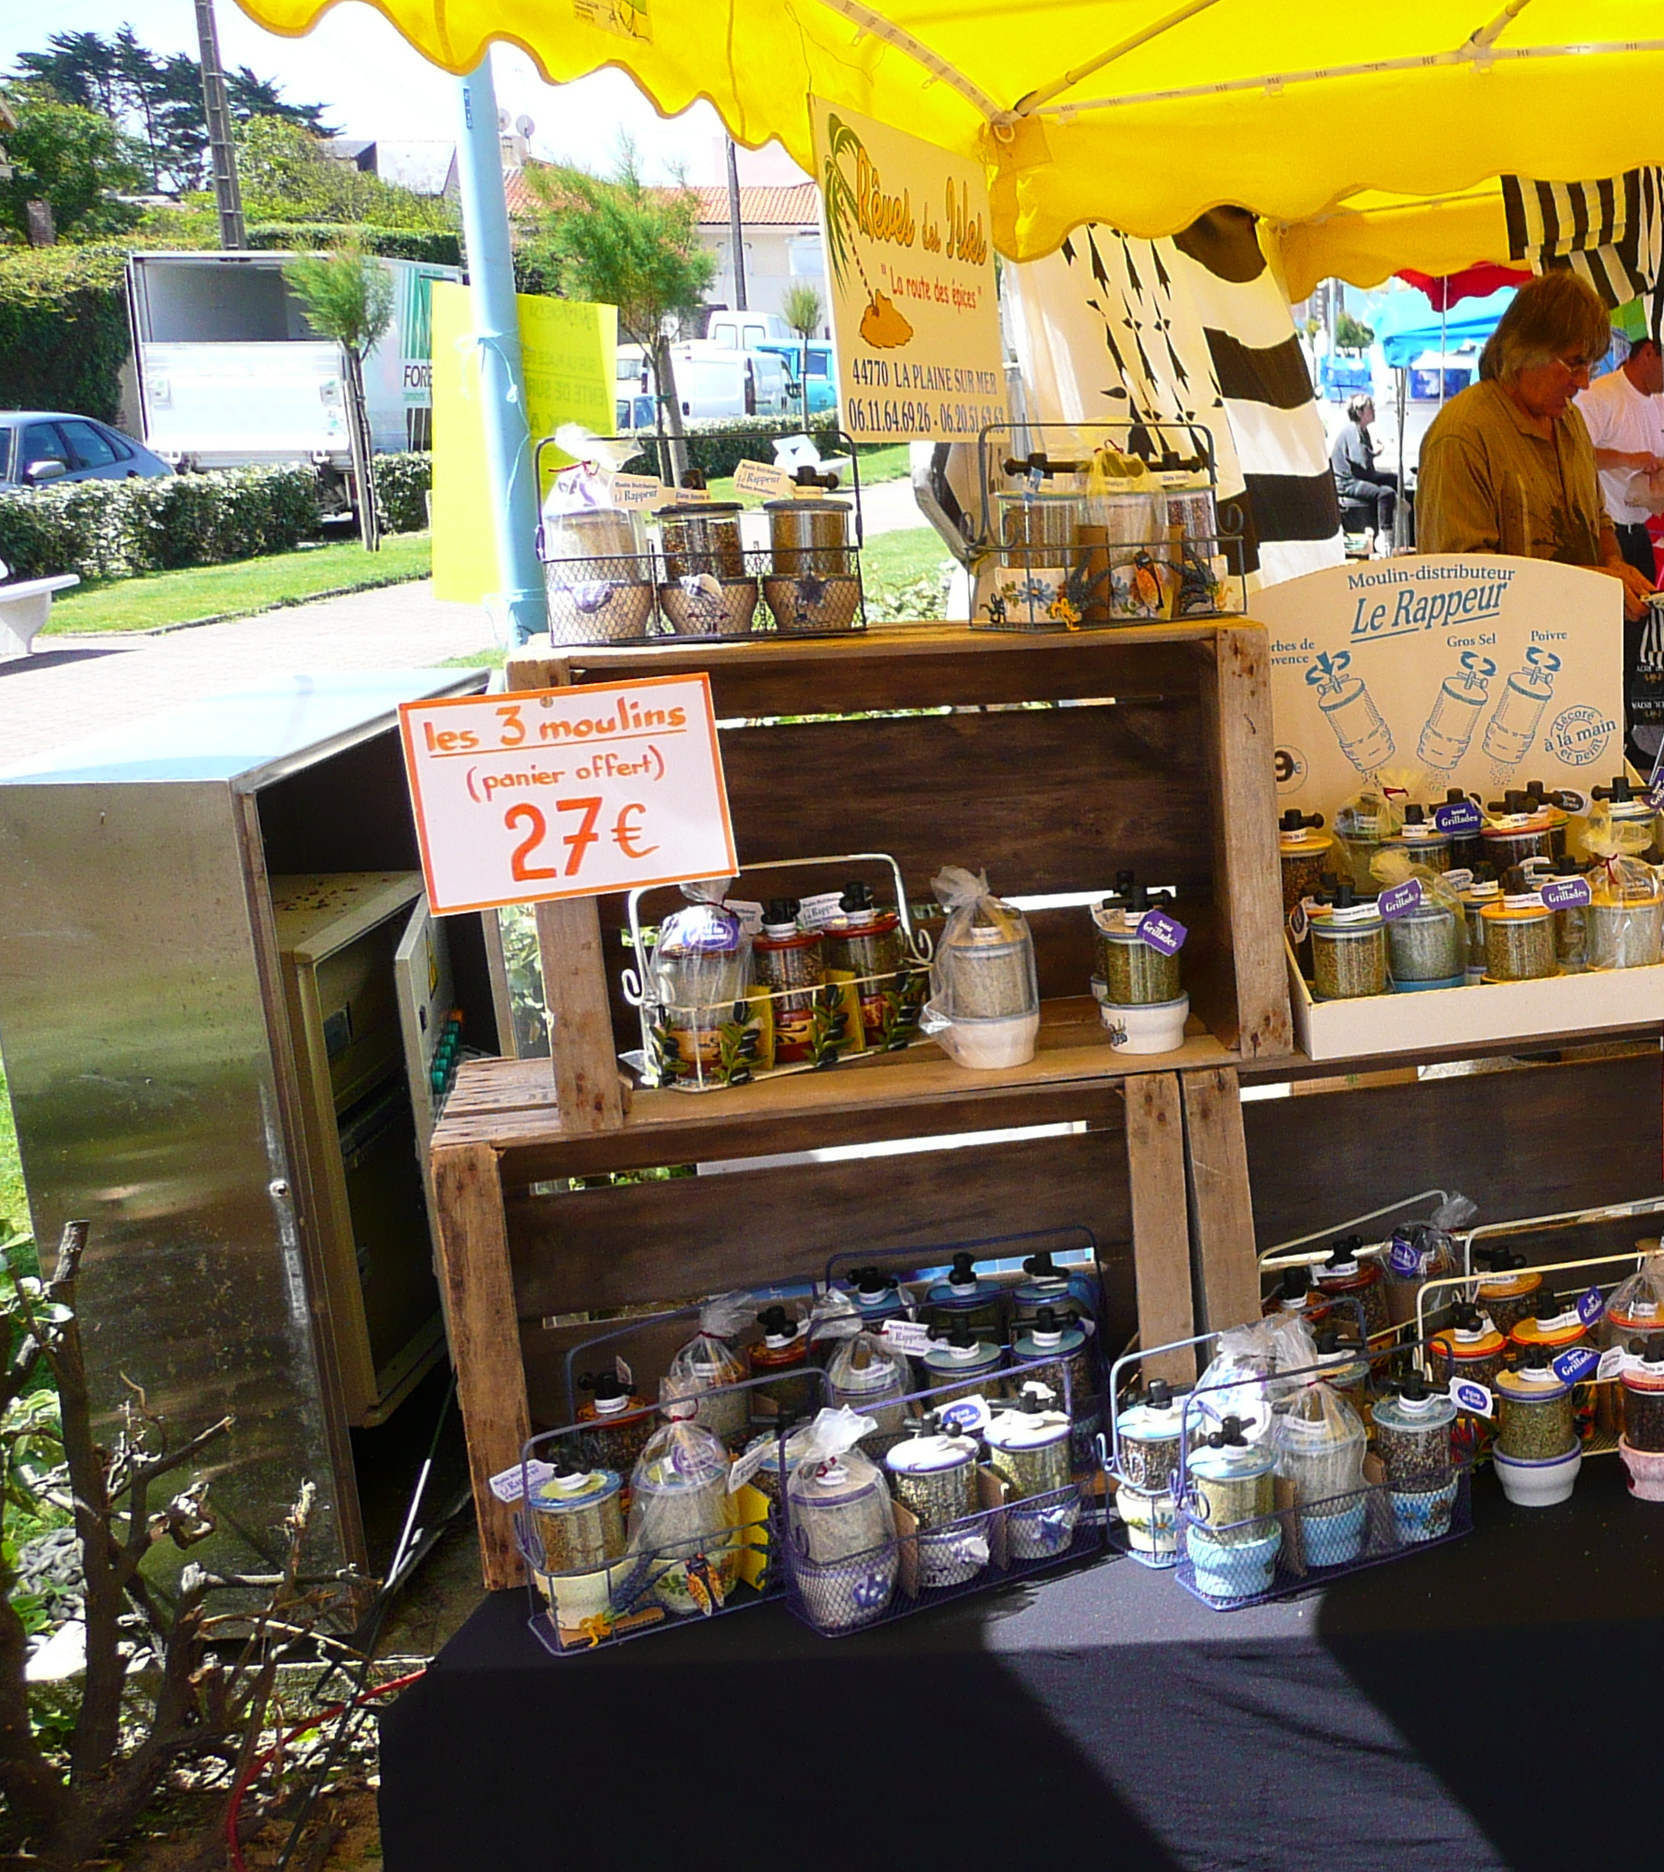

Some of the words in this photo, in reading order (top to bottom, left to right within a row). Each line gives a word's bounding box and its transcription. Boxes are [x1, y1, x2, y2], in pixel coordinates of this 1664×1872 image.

[906, 275, 931, 300] route
[934, 275, 949, 304] des
[853, 358, 889, 387] 44770
[894, 362, 910, 389] LA
[912, 364, 952, 392] PLAINE
[954, 368, 975, 393] SUR
[976, 370, 998, 395] MER
[849, 398, 931, 433] 06.11.64.69.26
[1347, 565, 1516, 590] Moulin-distributeur
[1351, 597, 1385, 635] Le
[1391, 582, 1508, 629] Rappeur
[1271, 640, 1296, 652] rbes
[1300, 638, 1315, 650] de
[1446, 635, 1472, 648] Gros
[1475, 632, 1496, 646] Sel
[1531, 630, 1567, 642] Poivre
[424, 721, 479, 752] les
[496, 705, 526, 746] 3
[540, 696, 686, 741] moulins
[1555, 710, 1595, 731] décoré
[1544, 738, 1554, 752] à
[1556, 734, 1573, 748] la
[1576, 719, 1616, 741] main
[1561, 748, 1572, 760] et
[1575, 738, 1603, 766] peint
[466, 765, 565, 803] (panier
[575, 744, 665, 782] offert)
[1441, 813, 1478, 827] Grillades
[1548, 888, 1587, 903] Grillades
